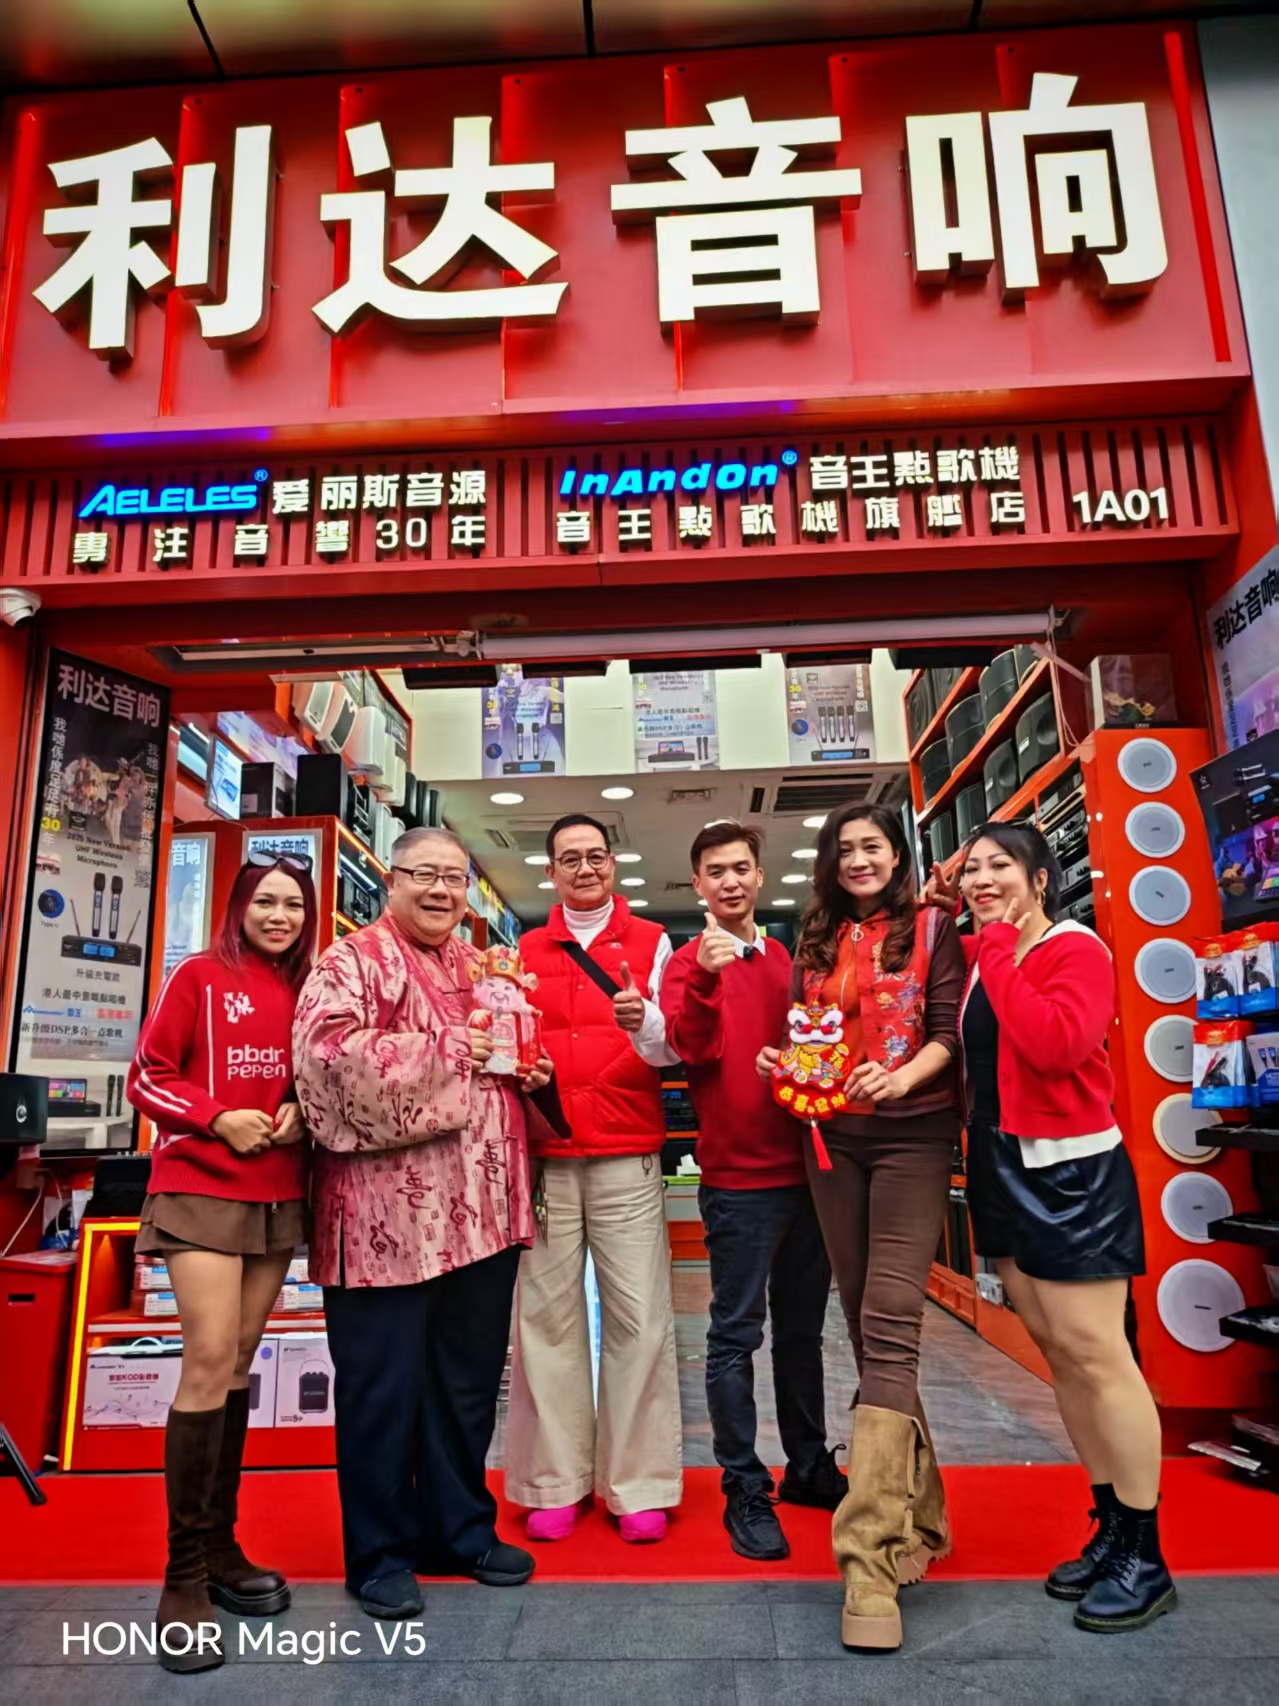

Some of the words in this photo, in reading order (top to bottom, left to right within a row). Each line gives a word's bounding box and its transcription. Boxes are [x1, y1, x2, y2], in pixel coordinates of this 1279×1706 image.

[32, 71, 1169, 349] 利达音响
[78, 484, 257, 517] AELELES
[272, 470, 486, 514] 爱丽斯音源
[559, 462, 778, 496] InAndOn
[809, 446, 1021, 490] 音王點歌機
[1072, 487, 1169, 524] 1A01
[1214, 568, 1279, 649] 利达音响
[57, 664, 161, 728] 利达音响
